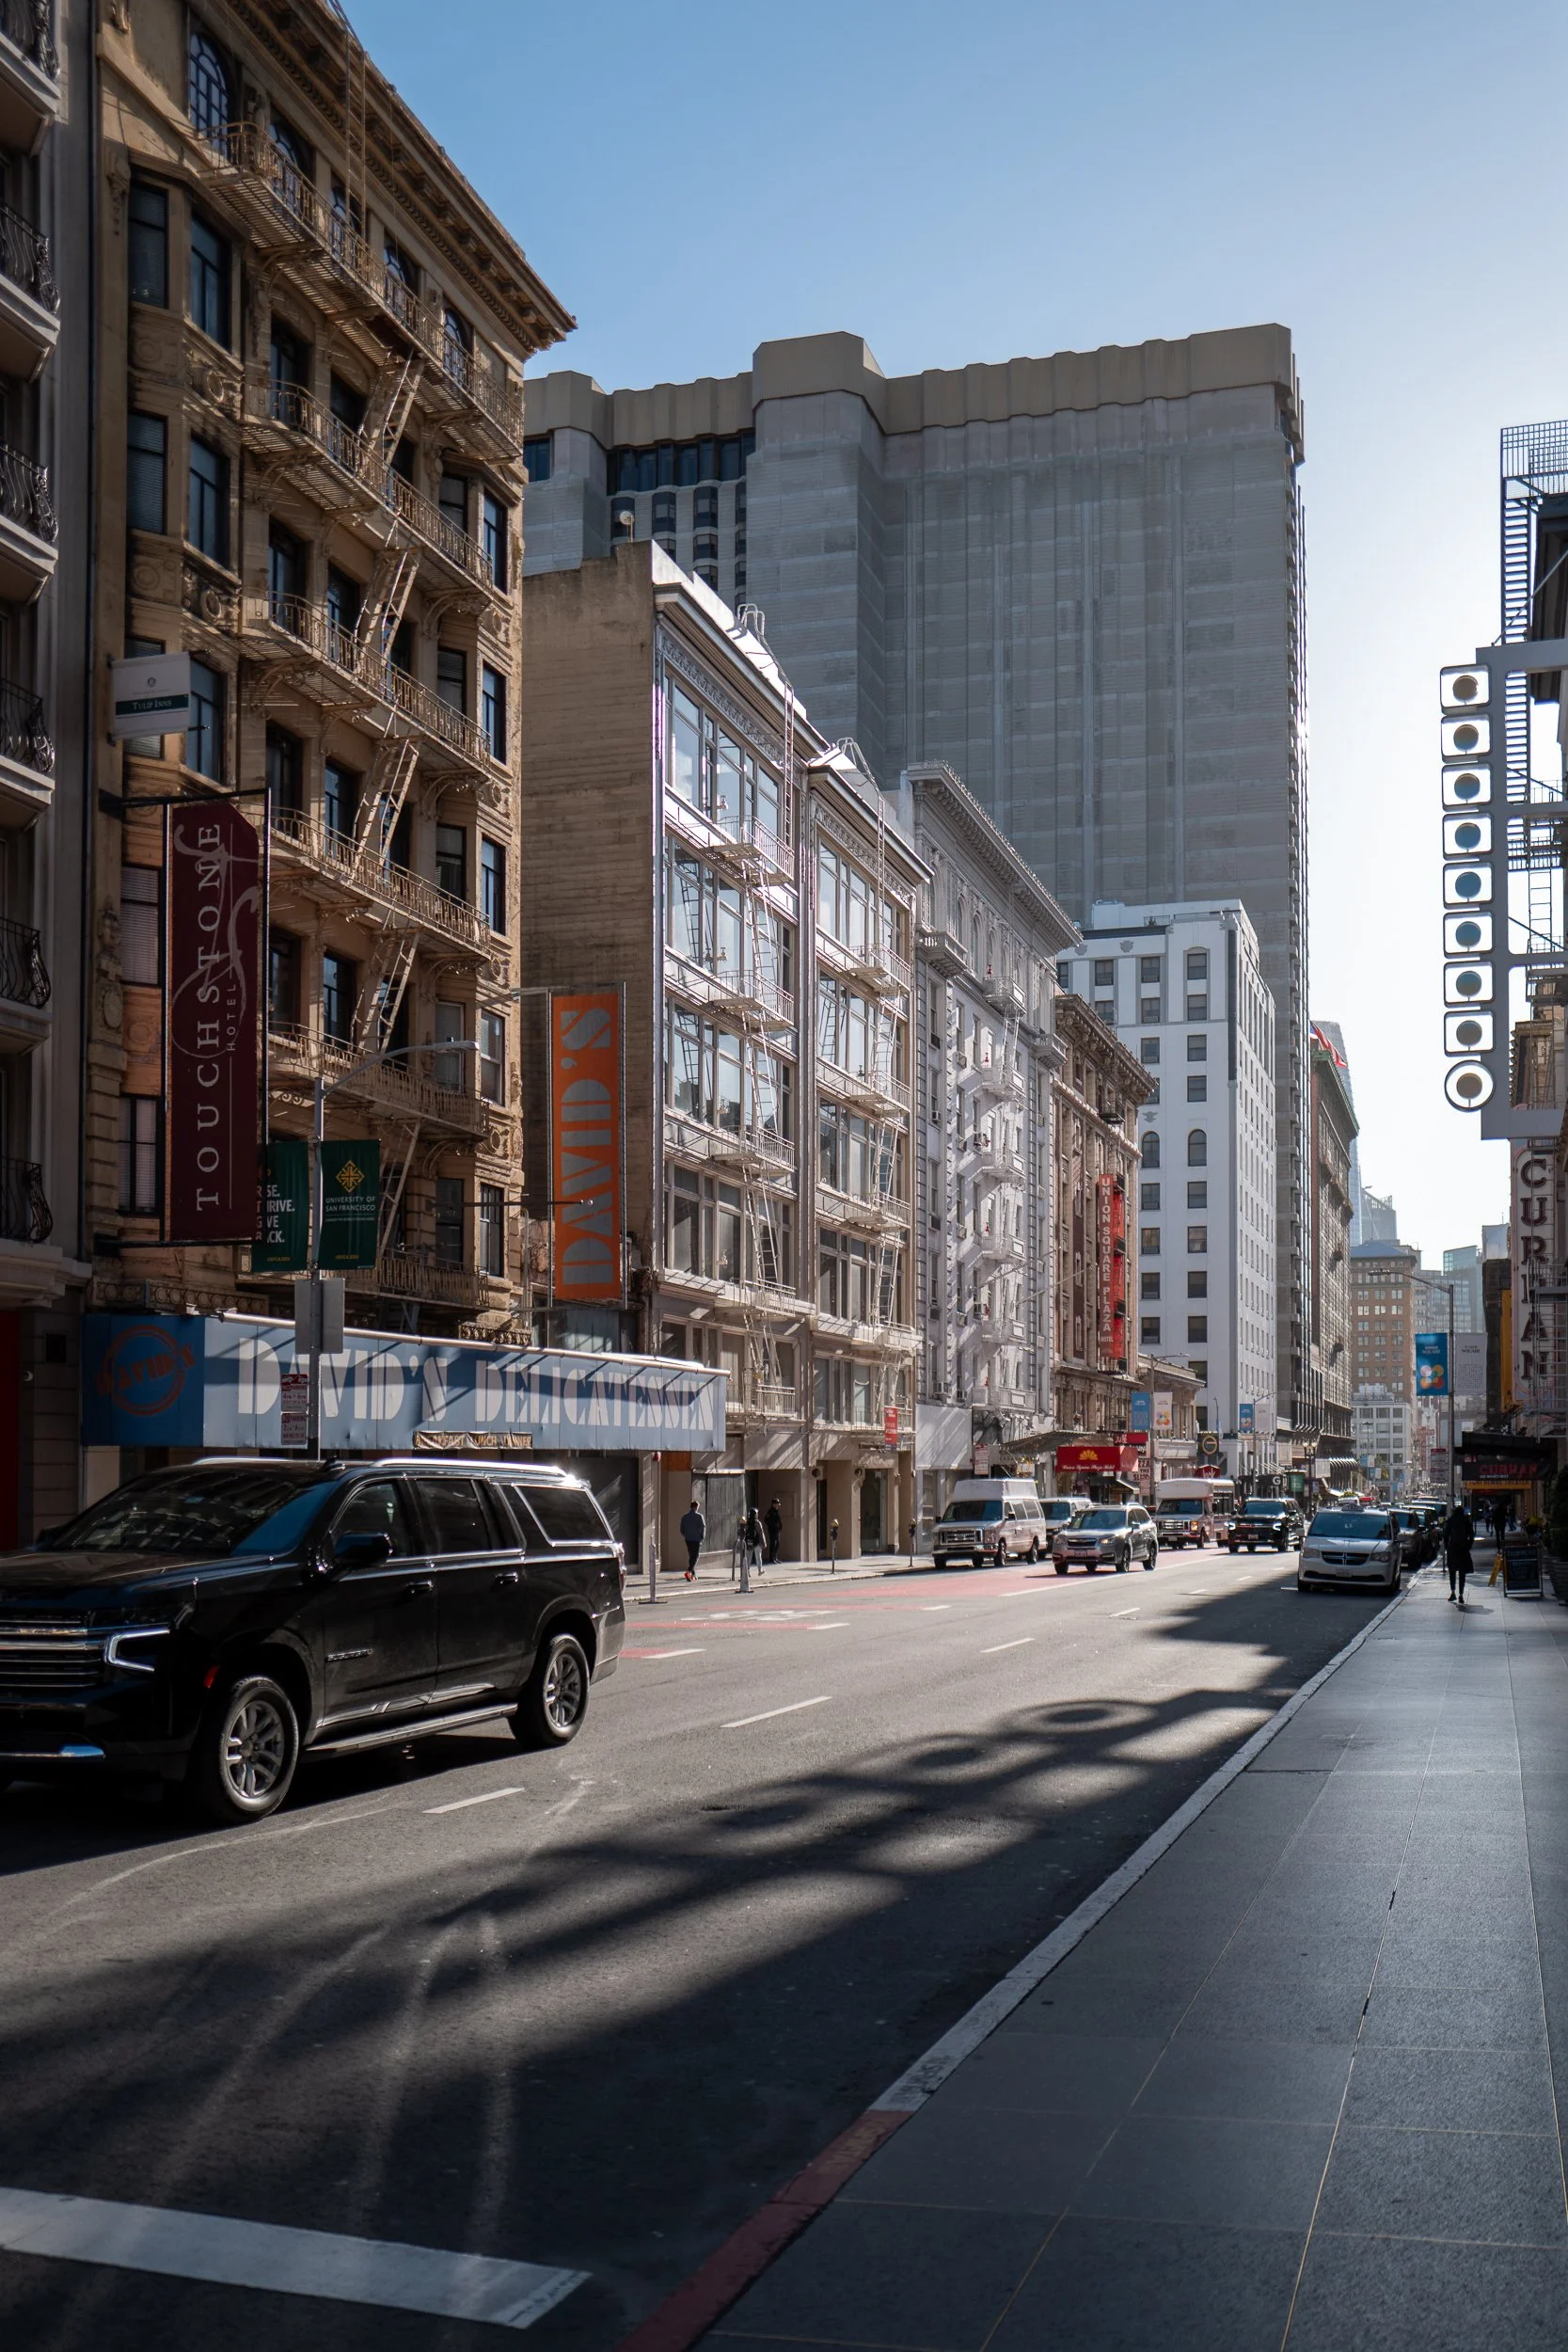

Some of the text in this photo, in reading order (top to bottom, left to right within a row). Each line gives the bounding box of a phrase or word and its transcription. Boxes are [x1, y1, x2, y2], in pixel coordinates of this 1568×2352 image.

[196, 823, 221, 1212] TOUCHSTONE
[227, 984, 236, 1052] HOTEL
[560, 1008, 612, 1286] DAVID'S
[256, 1215, 279, 1228] GVE
[257, 1184, 280, 1197] RSE.
[325, 1196, 364, 1204] UNIVERSITY
[1101, 1177, 1111, 1332] UNION SQUARE PLAZA
[475, 1359, 714, 1431] DELICATESSEN
